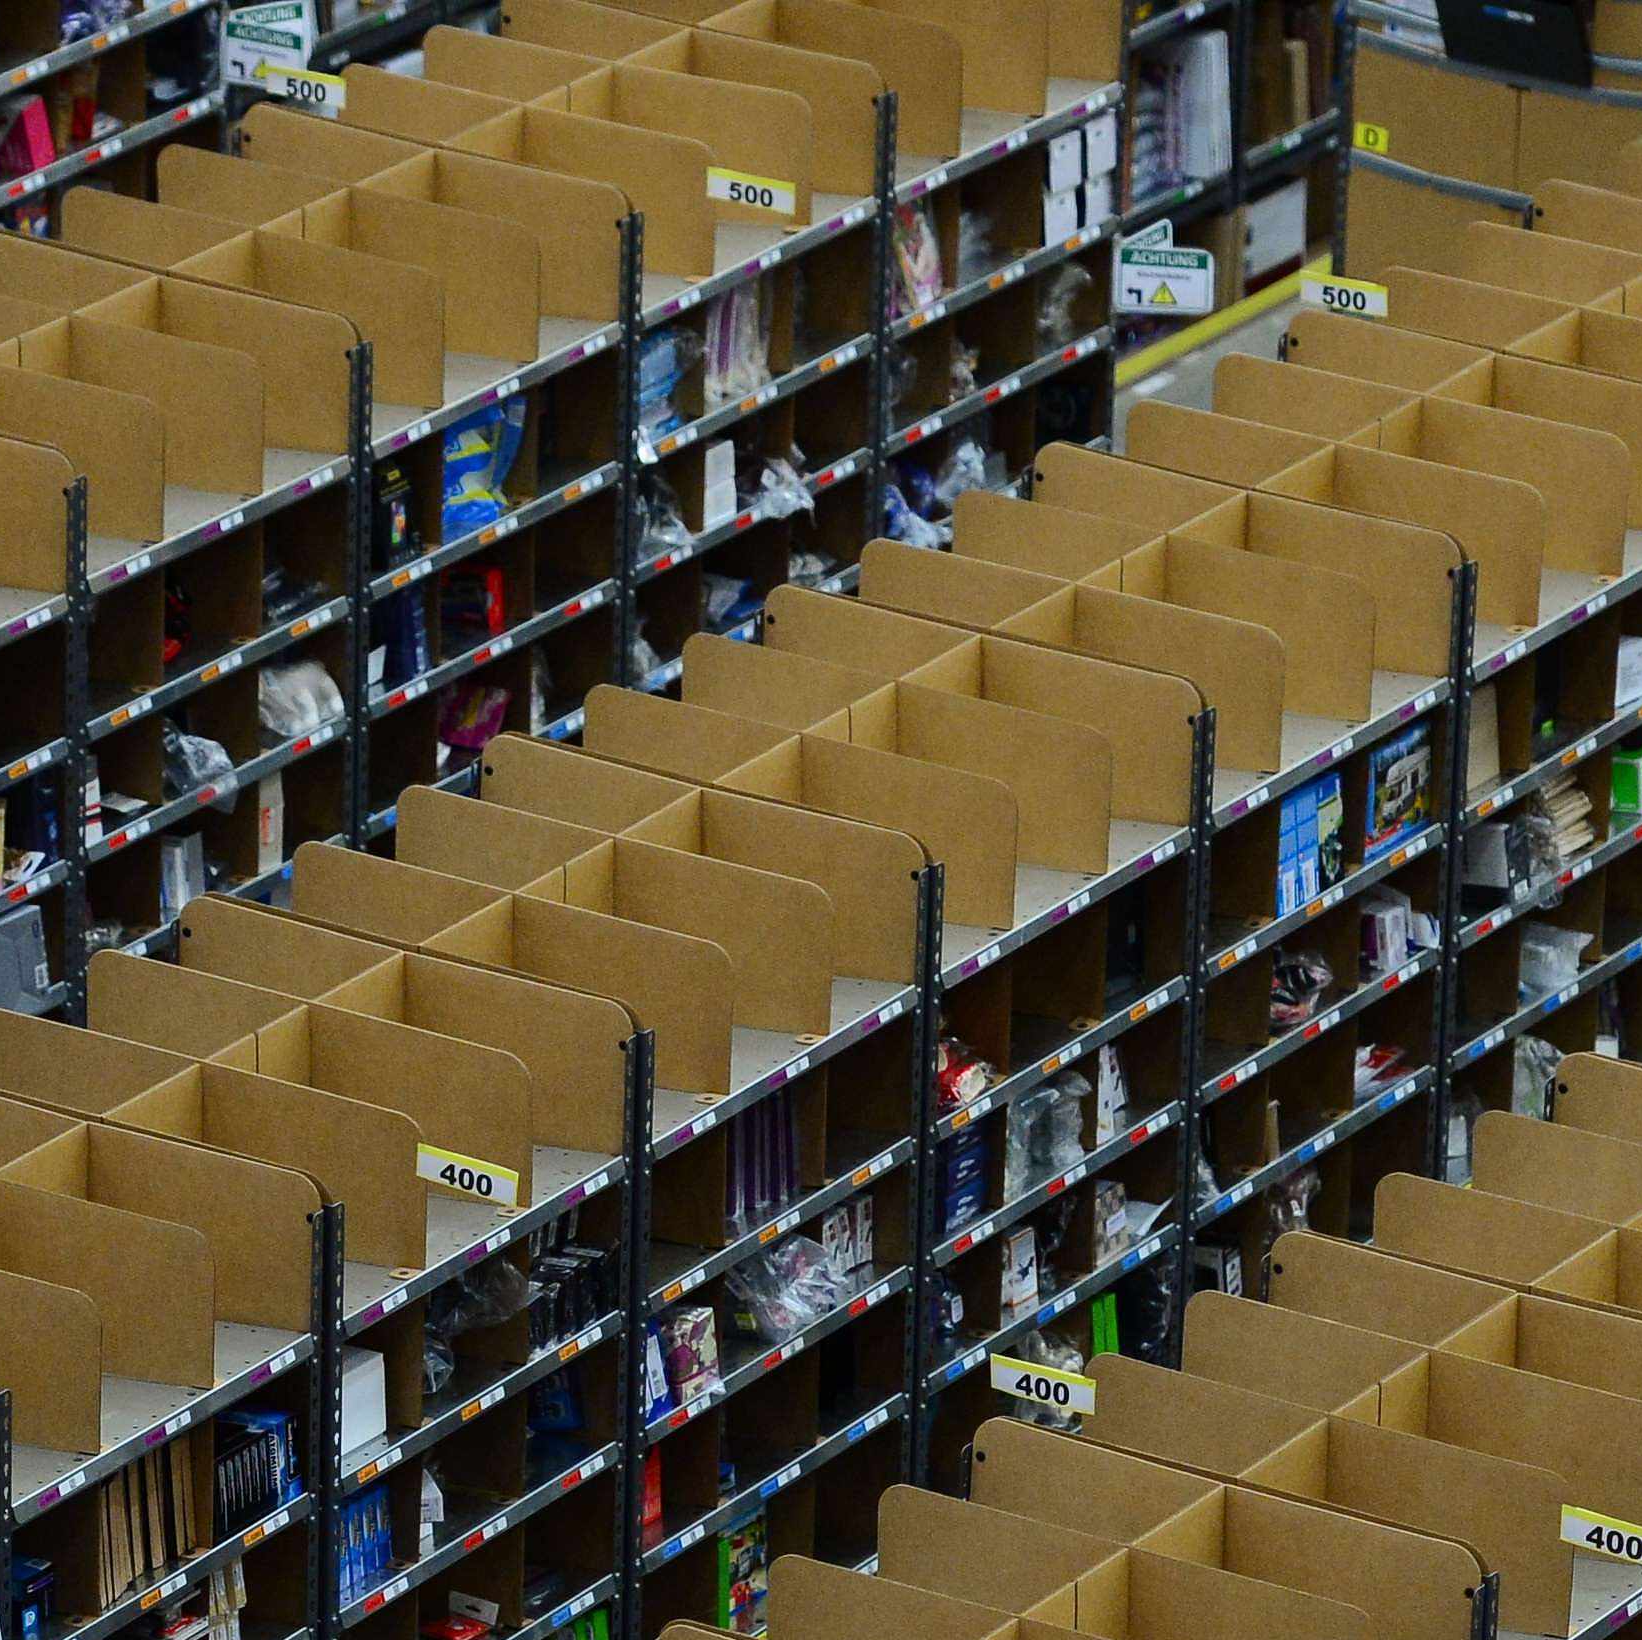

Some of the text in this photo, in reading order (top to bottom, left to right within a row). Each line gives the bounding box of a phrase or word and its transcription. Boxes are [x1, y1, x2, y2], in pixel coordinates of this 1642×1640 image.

[286, 77, 325, 102] 500
[1365, 127, 1379, 146] D
[730, 182, 772, 207] 500
[1130, 249, 1199, 267] ACHTUNG
[1323, 286, 1365, 310] 500
[440, 1164, 492, 1196] 400
[1016, 1374, 1069, 1405] 400
[1586, 1527, 1642, 1559] 400
